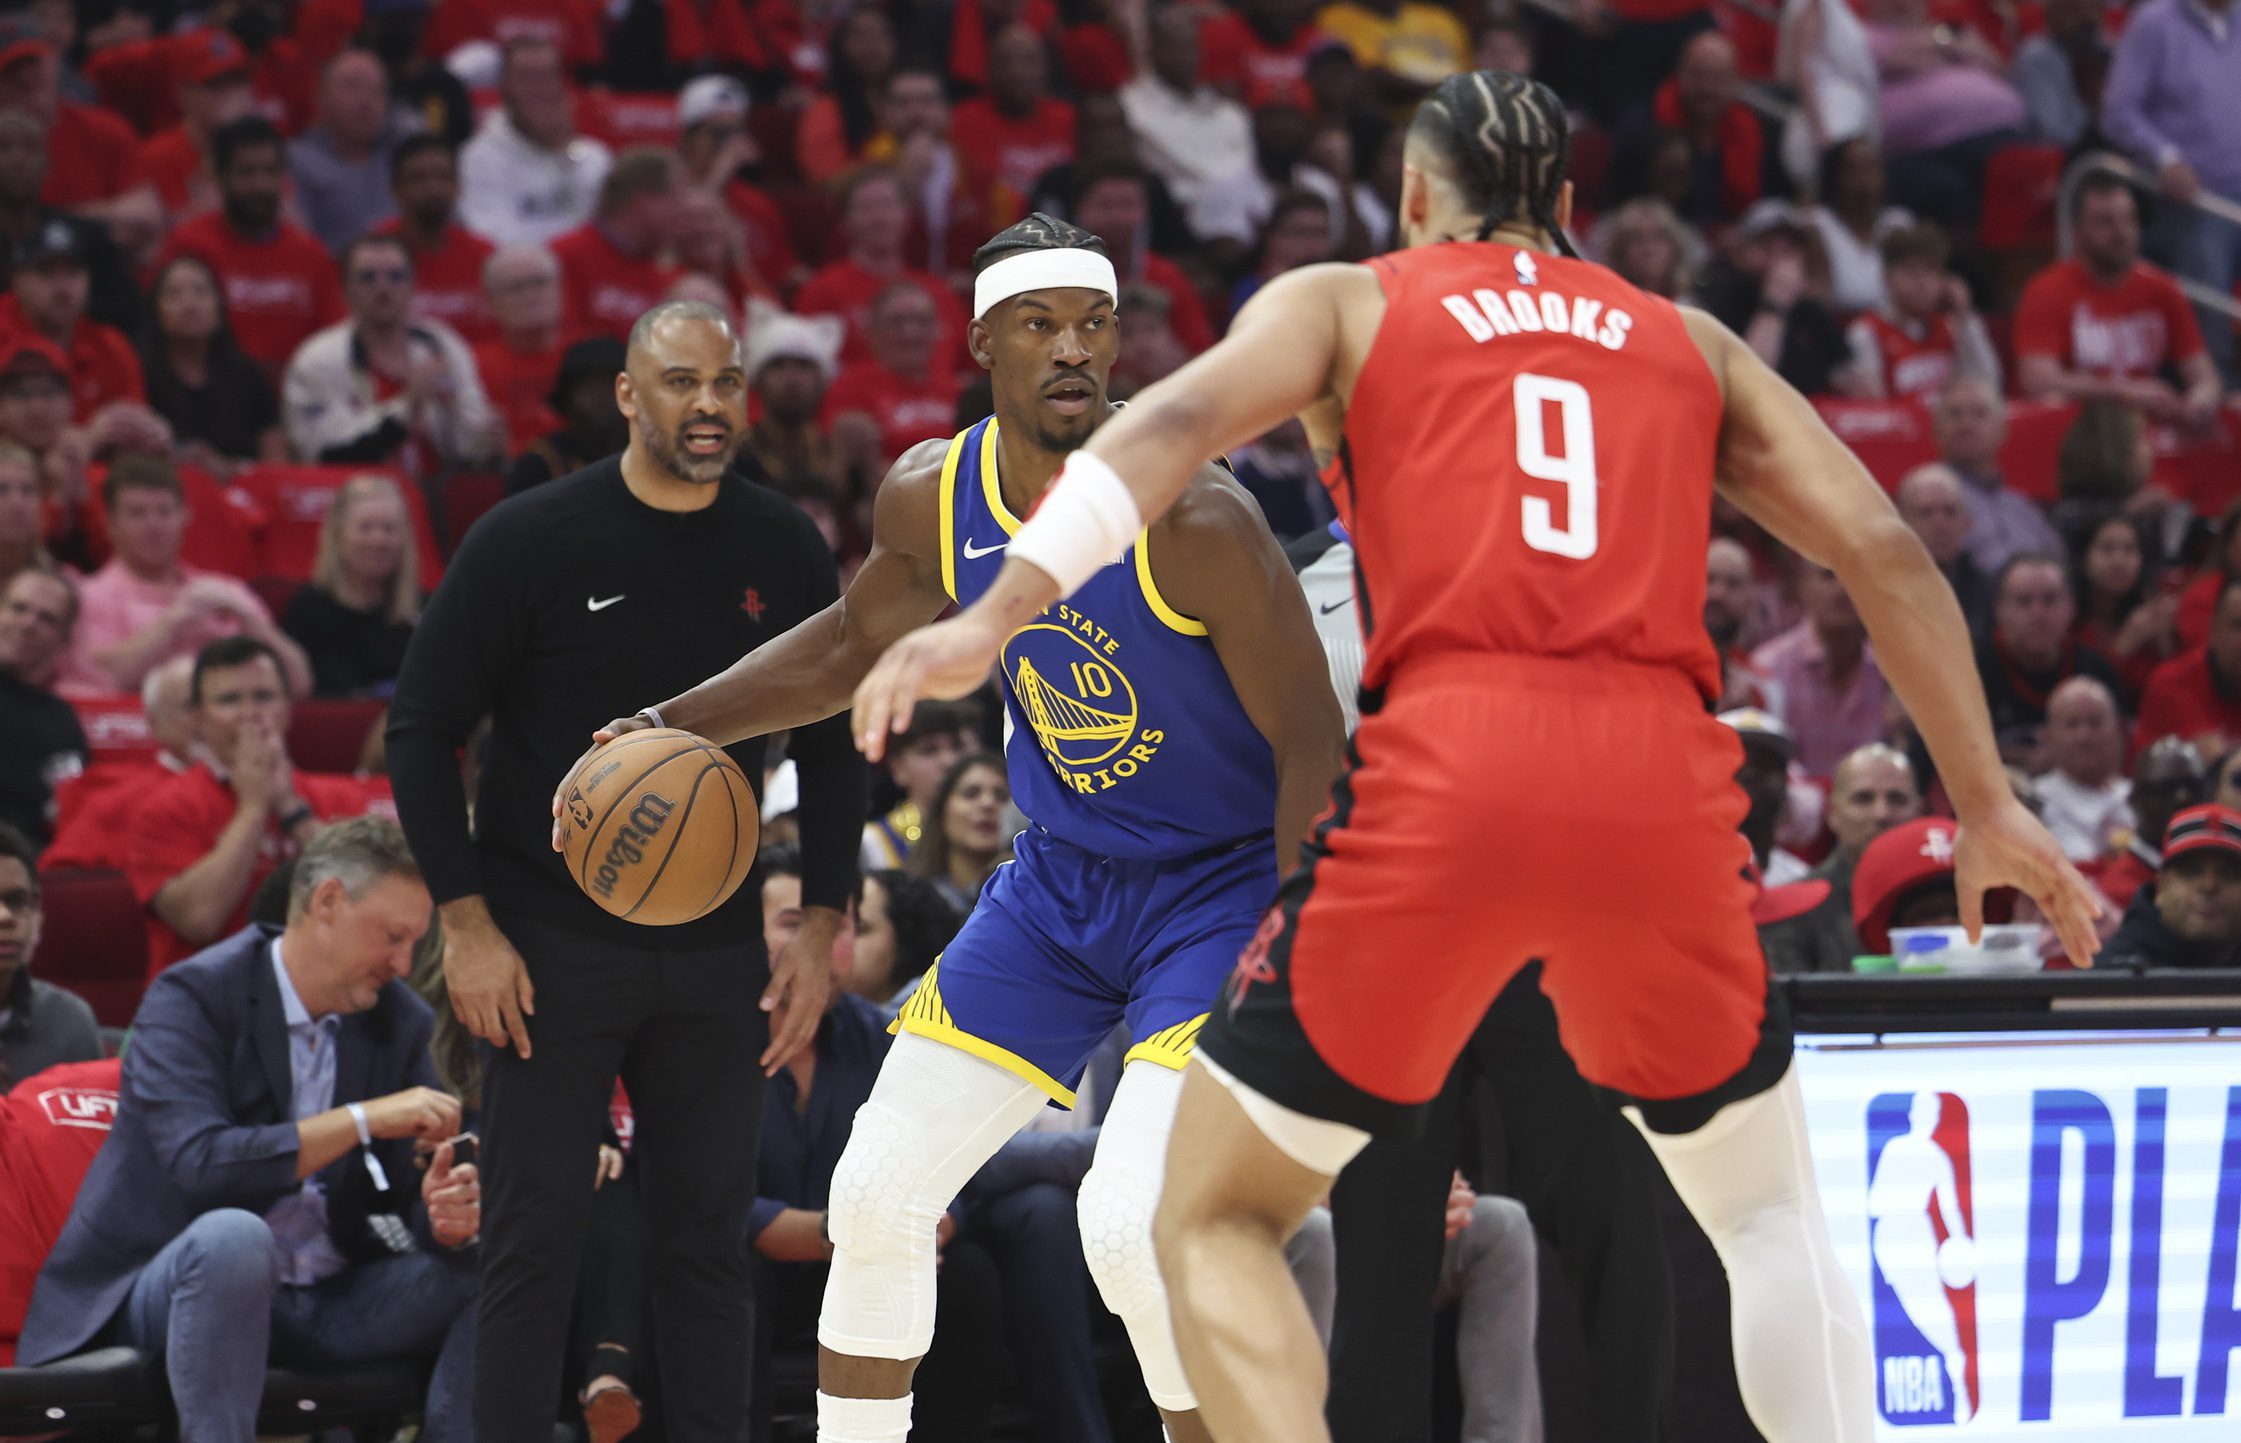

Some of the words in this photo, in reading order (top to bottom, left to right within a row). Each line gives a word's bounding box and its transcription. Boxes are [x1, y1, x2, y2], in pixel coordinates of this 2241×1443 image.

[1441, 288, 1633, 351] BROOKS
[1513, 371, 1598, 560] 9
[1059, 604, 1120, 656] STATE
[1070, 660, 1113, 698] 10
[1047, 728, 1165, 794] ARRIORS
[592, 791, 678, 899] Wilson
[1883, 1354, 1945, 1413] NBA
